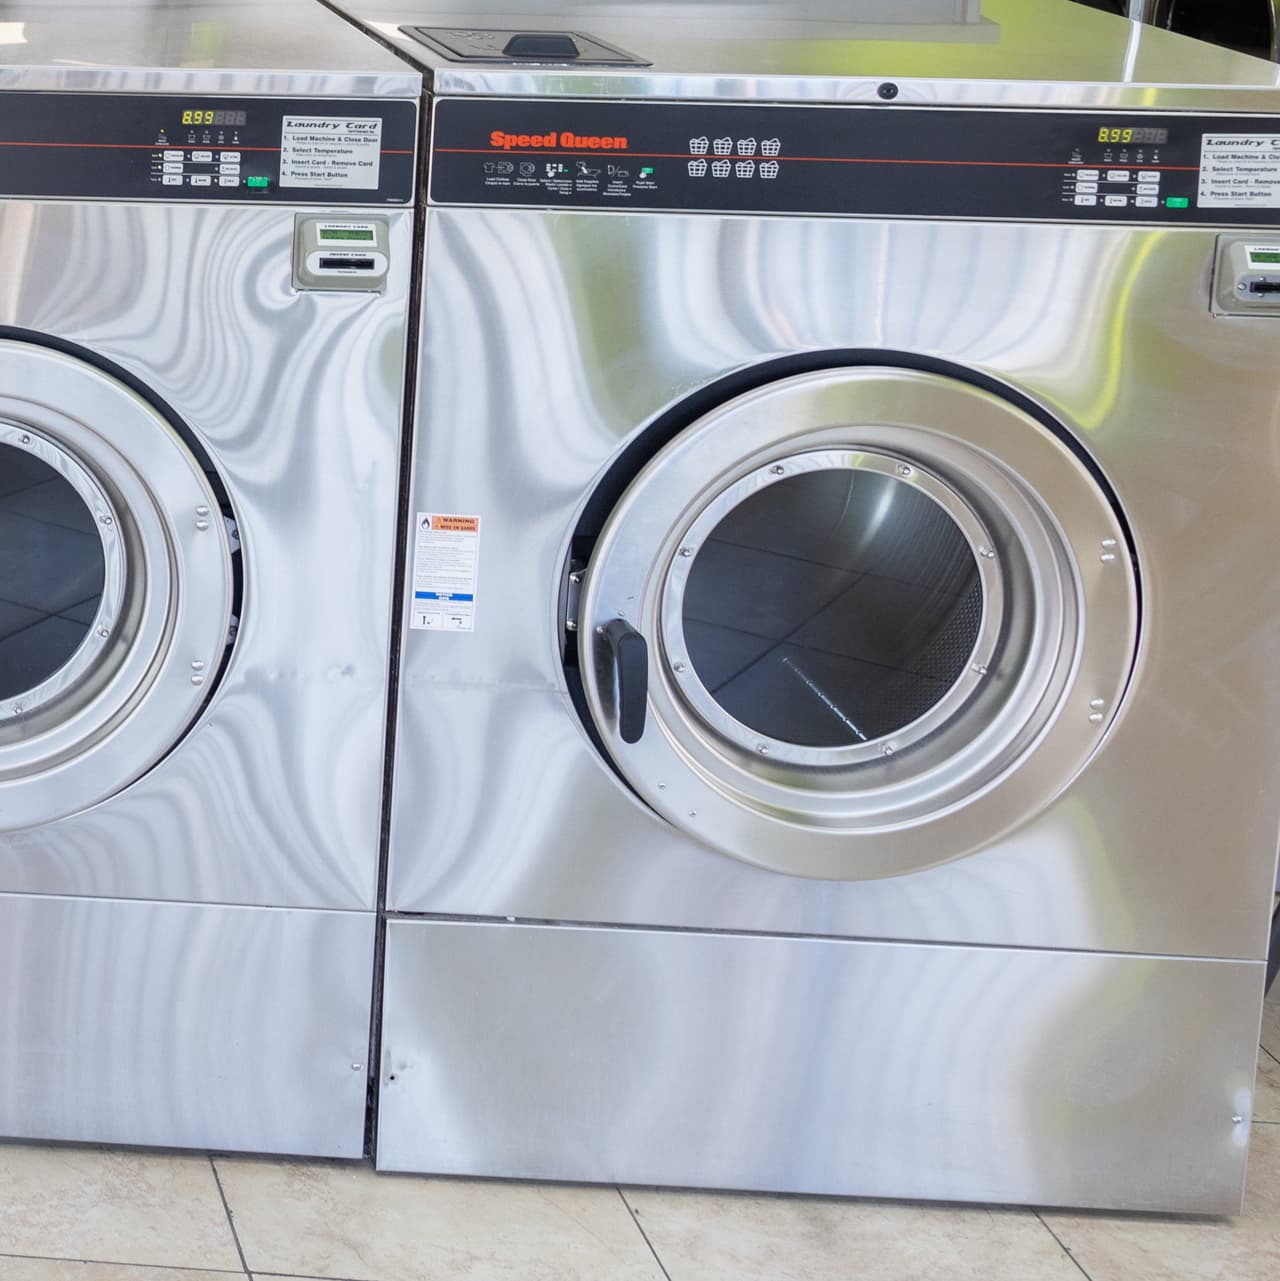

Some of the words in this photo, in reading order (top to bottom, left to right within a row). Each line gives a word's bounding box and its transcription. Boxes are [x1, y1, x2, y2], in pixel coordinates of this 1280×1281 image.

[286, 121, 340, 129] Laundry
[490, 131, 557, 150] Speed
[560, 132, 628, 149] Queen
[1206, 139, 1264, 147] Laundry
